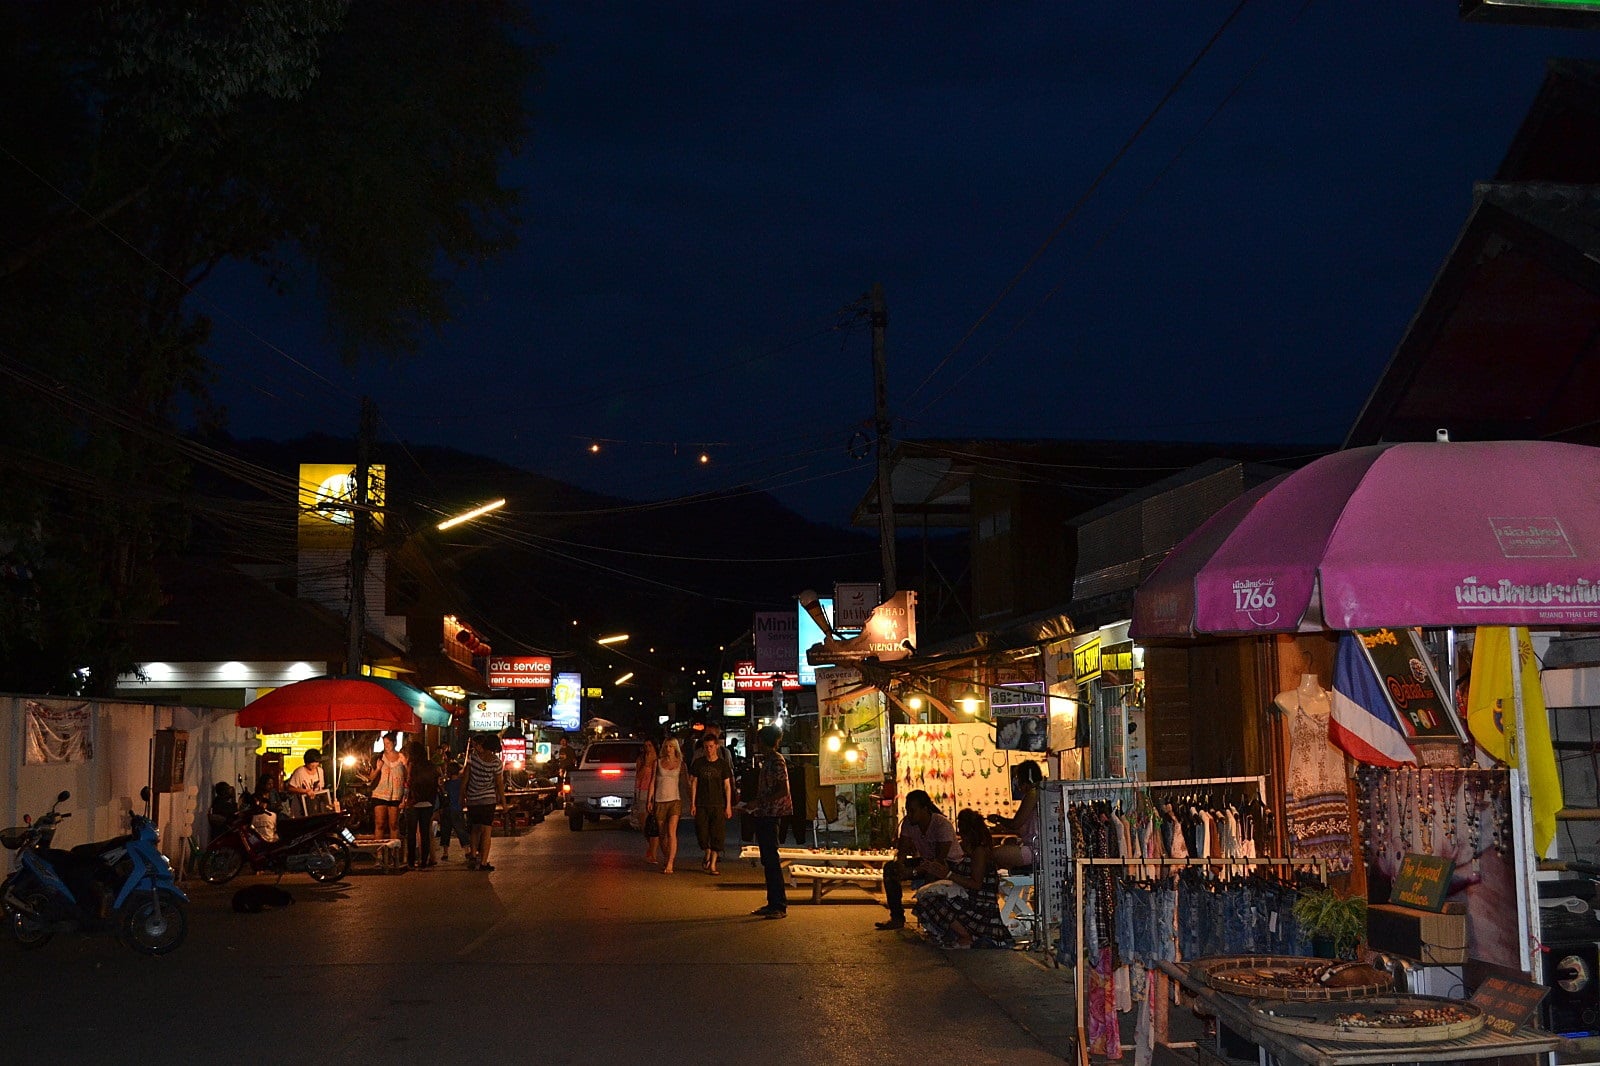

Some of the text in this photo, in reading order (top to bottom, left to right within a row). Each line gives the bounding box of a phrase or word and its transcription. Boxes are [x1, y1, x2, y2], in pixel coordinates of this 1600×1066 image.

[1233, 587, 1276, 609] 1766
[490, 660, 551, 672] aYa service
[491, 676, 506, 684] rent
[514, 676, 550, 684] motorbike
